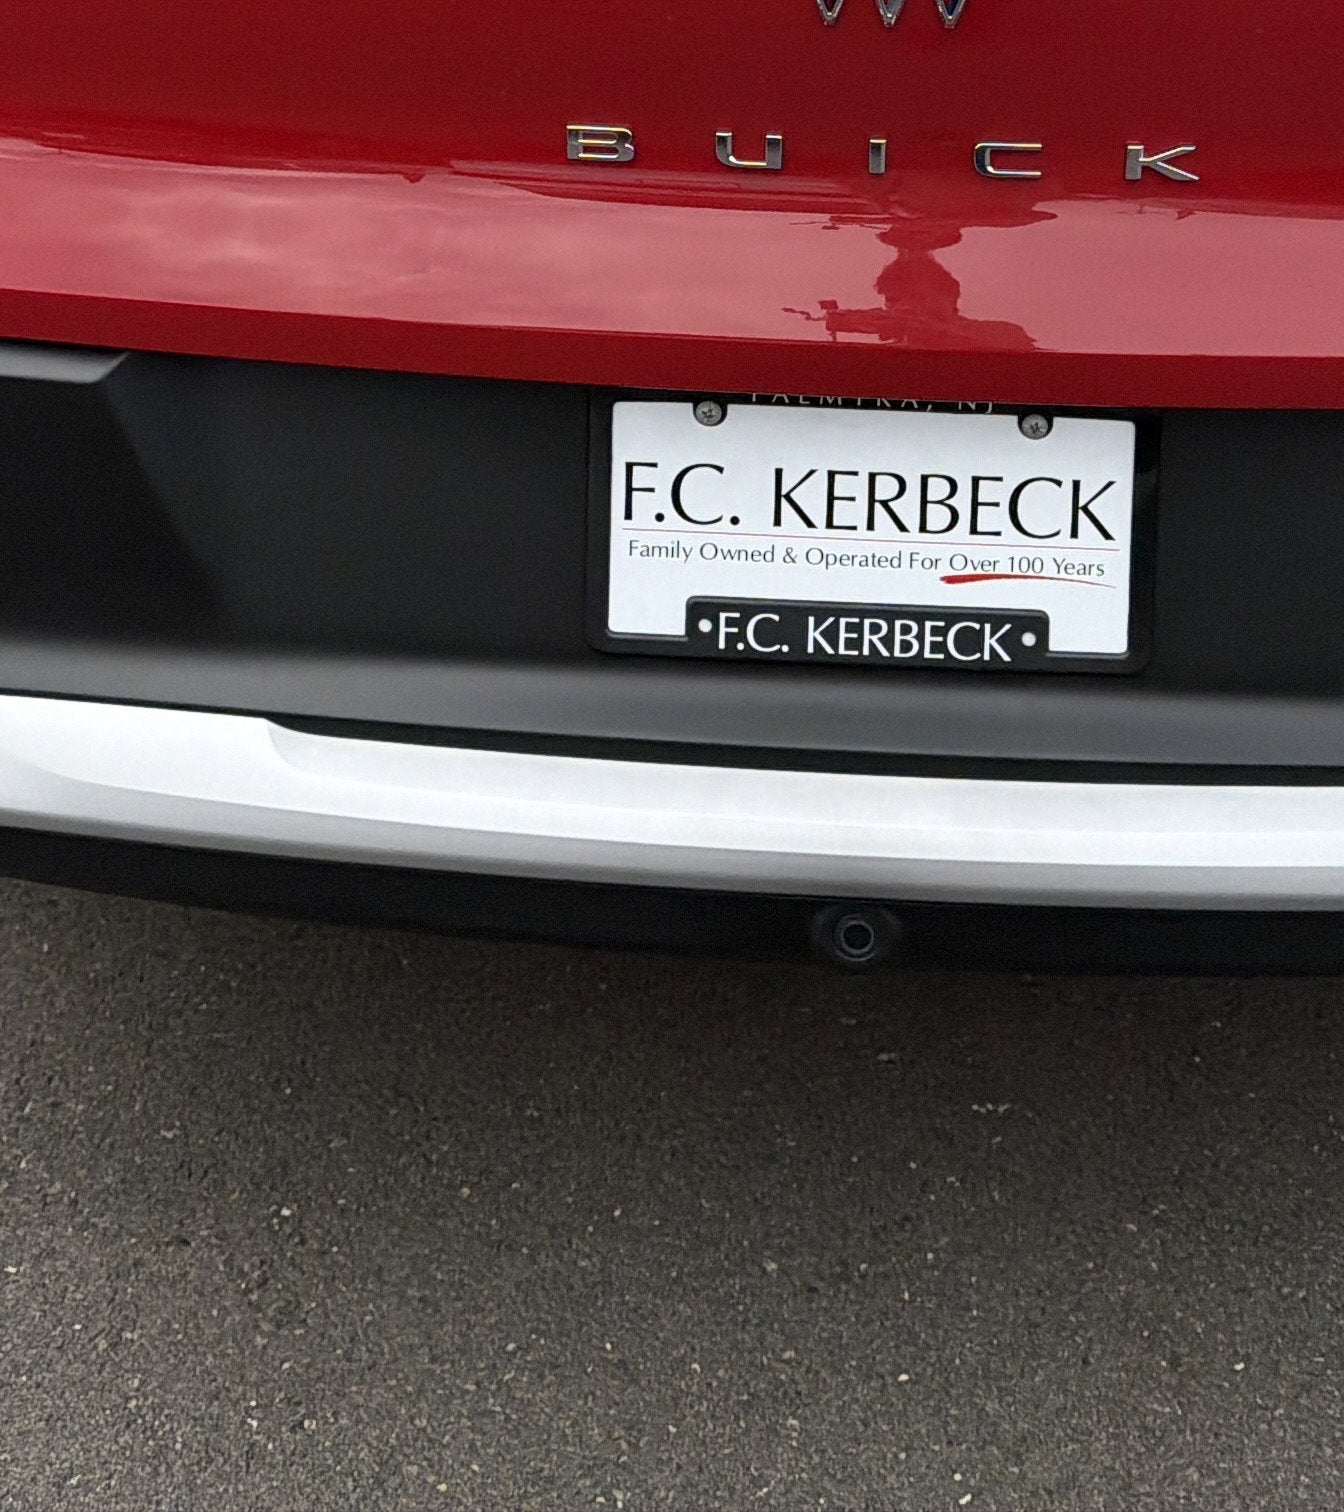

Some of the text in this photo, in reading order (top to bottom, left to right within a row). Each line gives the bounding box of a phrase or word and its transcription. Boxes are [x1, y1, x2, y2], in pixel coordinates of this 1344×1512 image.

[566, 123, 1199, 181] BUICK
[623, 461, 1116, 542] F.C. KERBECK
[628, 539, 1105, 577] Family Owned & Operated For Over 100 Years
[717, 611, 1012, 662] F.C. KERBECK
